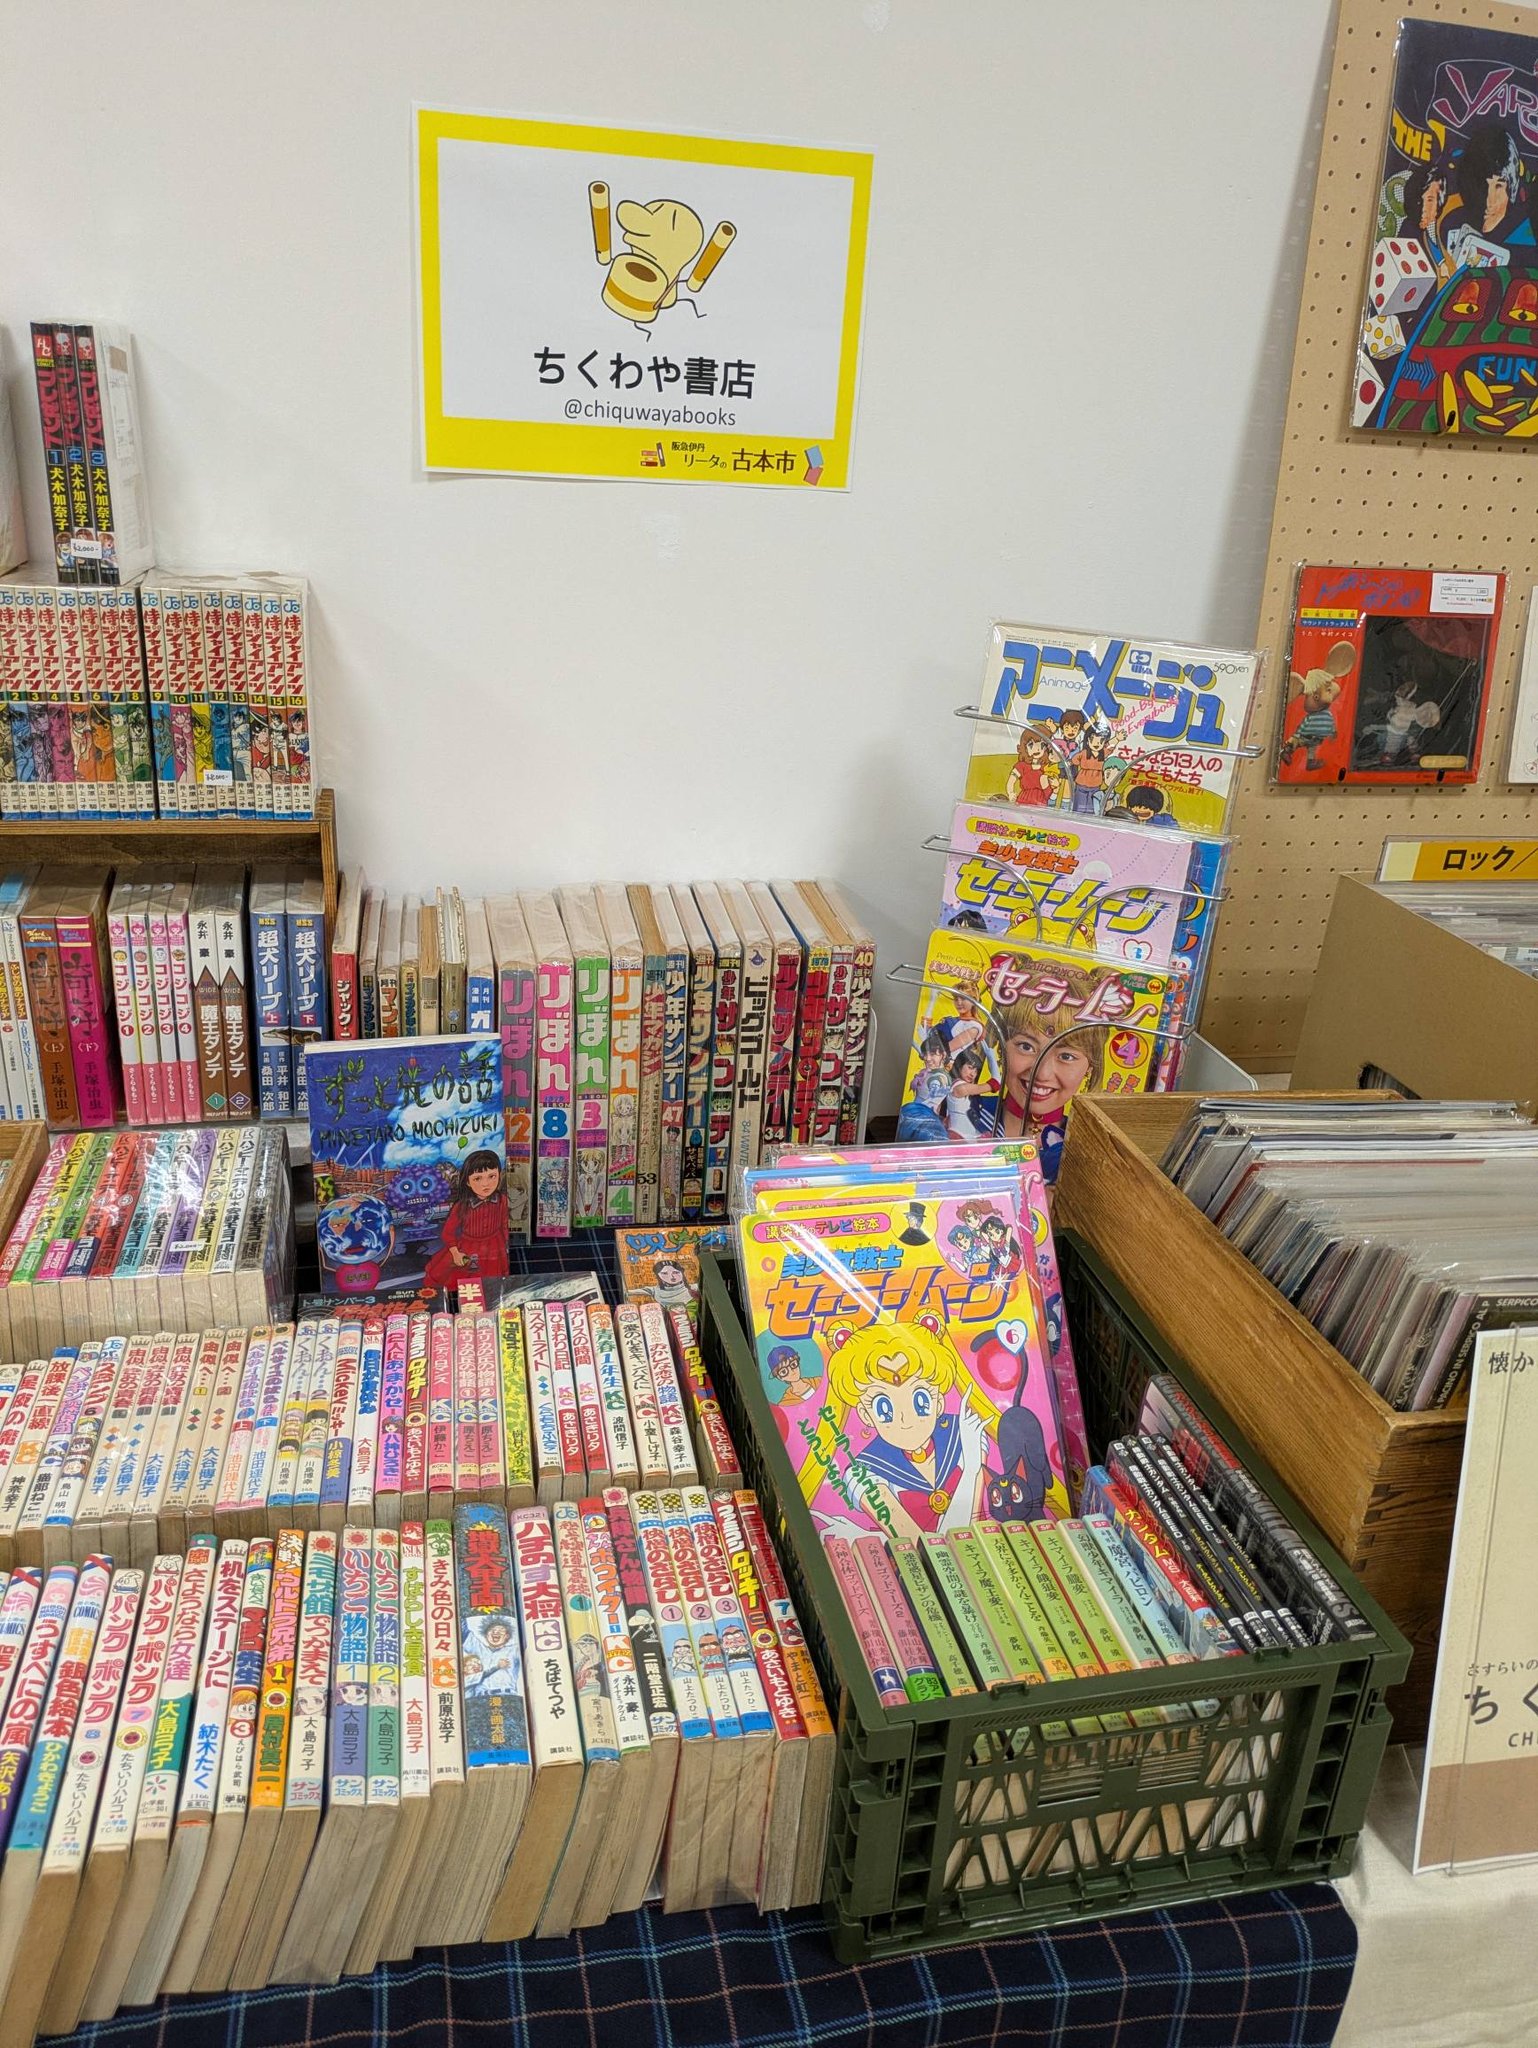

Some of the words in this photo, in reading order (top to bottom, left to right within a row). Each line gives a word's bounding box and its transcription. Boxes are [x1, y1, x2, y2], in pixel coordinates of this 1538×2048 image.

[1392, 108, 1433, 162] THE
[533, 346, 756, 400] ちくわや書店
[564, 398, 737, 427] @chiquwayabooks
[671, 441, 706, 453] 阪急伊丹
[683, 453, 727, 471] リータの
[731, 448, 797, 474] 古本市
[50, 467, 69, 531] 犬木加奈子
[70, 464, 88, 527] 犬木加奈子
[92, 468, 111, 531] 犬木加奈子
[264, 614, 285, 696] 侍ジャイアンツ
[284, 614, 304, 696] 侍ジャイアンツ
[1038, 675, 1088, 693] Animage
[991, 640, 1228, 749] アニメージュ
[1117, 746, 1223, 773] さよなら13人の
[1131, 766, 1202, 787] 子どもたち
[976, 820, 1072, 848] 講談社のテレビ絵本
[977, 840, 1080, 875] 美少女戦士
[954, 857, 1172, 935] セーラームーン
[257, 931, 289, 1013] 超犬リープ
[295, 931, 320, 1013] 超犬リープ
[854, 952, 874, 966] 40
[984, 953, 1158, 1026] セーラームーン
[114, 963, 131, 1022] コジコジ
[127, 1066, 138, 1104] さくらももこ
[135, 963, 153, 1022] コジコジ
[148, 1066, 158, 1103] さくらももこ
[154, 963, 171, 1022] コジコジ
[166, 1064, 176, 1102] さくらももこ
[172, 963, 190, 1022] コジコジ
[186, 1064, 196, 1103] さくらももこ
[200, 1006, 223, 1079] 魔王ダンテ
[225, 1006, 247, 1079] 魔王ダンテ
[501, 978, 535, 1099] りぼん
[538, 974, 570, 1091] りぼん
[576, 969, 610, 1085] りぼん
[611, 975, 641, 1096] りぼん
[641, 984, 664, 1078] 少年マガジン
[665, 971, 686, 1099] 少年サンデー
[737, 977, 766, 1108] ビッグゴールド
[844, 978, 871, 1087] 少年サンデー
[52, 1062, 69, 1110] 手塚治虫
[85, 1062, 103, 1111] 手塚治虫
[261, 1066, 274, 1087] 桑田
[262, 1091, 274, 1111] 次郎
[276, 1065, 288, 1086] 平井
[277, 1091, 290, 1111] 和正
[318, 1125, 406, 1149] MINETARO
[411, 1116, 499, 1140] MOCHIZUKI
[542, 1108, 568, 1139] 8
[582, 1102, 602, 1129] 3
[663, 1107, 682, 1124] 47
[764, 1128, 785, 1140] 34
[609, 1186, 633, 1216] 4
[637, 1172, 657, 1185] 53
[765, 1216, 881, 1239] 講談社のテレビ絵本
[780, 1244, 904, 1278] 美少女戦士
[765, 1263, 1017, 1339] セーラームーン
[1476, 1308, 1489, 1320] AL
[1496, 1298, 1538, 1307] SERPICO
[406, 1323, 428, 1399] ファミコンロッキー
[458, 1329, 476, 1388] エリカの丘の物語
[476, 1329, 496, 1388] エリカの丘の物語
[502, 1322, 519, 1350] Flight
[530, 1312, 550, 1372] スターライト
[622, 1324, 651, 1390] 愛の心をキャンバスに
[1453, 1358, 1464, 1370] IN
[1458, 1322, 1481, 1358] SERPICO
[1488, 1350, 1535, 1375] 懐か
[28, 1360, 70, 1431] 放課後一直線
[331, 1358, 358, 1405] Mickey
[358, 1348, 382, 1416] 毎日が夏休み
[549, 1314, 571, 1370] ひまわり日記
[562, 1412, 580, 1456] あさぎり夕
[569, 1310, 592, 1366] アリスの時間
[583, 1408, 600, 1451] あさぎり夕
[595, 1330, 624, 1388] 青春1年生
[612, 1416, 629, 1451] 波間信子
[650, 1344, 679, 1404] おかしな恋の物語
[670, 1426, 690, 1462] 森谷幸子
[1437, 1370, 1458, 1404] PACINO
[329, 1406, 346, 1436] ミッキー
[464, 1426, 475, 1458] 原ちえこ
[481, 1426, 493, 1458] 原ちえこ
[90, 1456, 112, 1495] 大谷博子
[114, 1452, 138, 1496] 大谷博子
[139, 1453, 164, 1498] 大谷博子
[170, 1448, 194, 1492] 大谷博子
[197, 1446, 220, 1491] 大谷博子
[355, 1437, 372, 1475] 大島弓子
[383, 1434, 402, 1477] 八神ひろき
[798, 1419, 855, 1512] とうじょう!
[818, 1406, 897, 1540] セーラージュピター
[832, 1542, 870, 1616] 六神合体ゴッドマーズ
[867, 1542, 905, 1618] 六神合体ゴッドマーズ2
[902, 1552, 942, 1622] 連帯惑星ピザンの危機
[964, 1544, 1001, 1606] キマイラ魔王変
[1018, 1538, 1060, 1601] キマイラ餓狼変
[1077, 1534, 1123, 1605] 幻獣少年キマイラ
[1107, 1544, 1152, 1608] 魔宮バビロン
[102, 1595, 138, 1652] パンク
[142, 1578, 178, 1636] パンク
[164, 1568, 208, 1682] さようなら女達
[204, 1560, 244, 1688] 机をステージに
[266, 1572, 302, 1664] ウルトラ兄弟
[298, 1554, 335, 1686] ミモザ館でつかまえて
[339, 1550, 369, 1664] いちご物語
[373, 1550, 399, 1664] いちご物語
[429, 1558, 454, 1653] きみ色の日々
[516, 1522, 563, 1622] ハチのす大将
[543, 1658, 566, 1719] ちばてつや
[642, 1528, 680, 1602] 快僧のざらし
[682, 1678, 700, 1719] 山上たつひこ
[668, 1528, 708, 1602] 快僧のざらし
[714, 1676, 732, 1718] 山上たつひこ
[692, 1523, 734, 1596] 快僧のざらし
[739, 1672, 758, 1712] 山上たつひこ
[717, 1506, 760, 1609] ファミコンロッキー
[759, 1650, 797, 1718] あさいもとゆき
[2, 1620, 60, 1747] うすべにの嵐
[84, 1660, 125, 1723] ポンク
[127, 1641, 164, 1704] ポンク
[378, 1665, 396, 1683] 2
[622, 1674, 636, 1697] 永井
[642, 1652, 668, 1708] 二階堂正宏
[1467, 1659, 1538, 1677] さすらいの
[44, 1660, 88, 1739] 銀色絵本
[404, 1698, 424, 1754] 大島弓子
[438, 1692, 456, 1744] 前原滋子
[612, 1678, 626, 1722] ダイナミックプロ
[150, 1700, 182, 1769] 大島弓子
[192, 1724, 222, 1790] 紡木たく
[300, 1716, 320, 1771] 大島弓子
[342, 1709, 360, 1766] 大島弓子
[377, 1709, 394, 1766] 大島弓子
[61, 1772, 92, 1836] たちいりハルコ
[107, 1752, 135, 1814] たちいりハルコ
